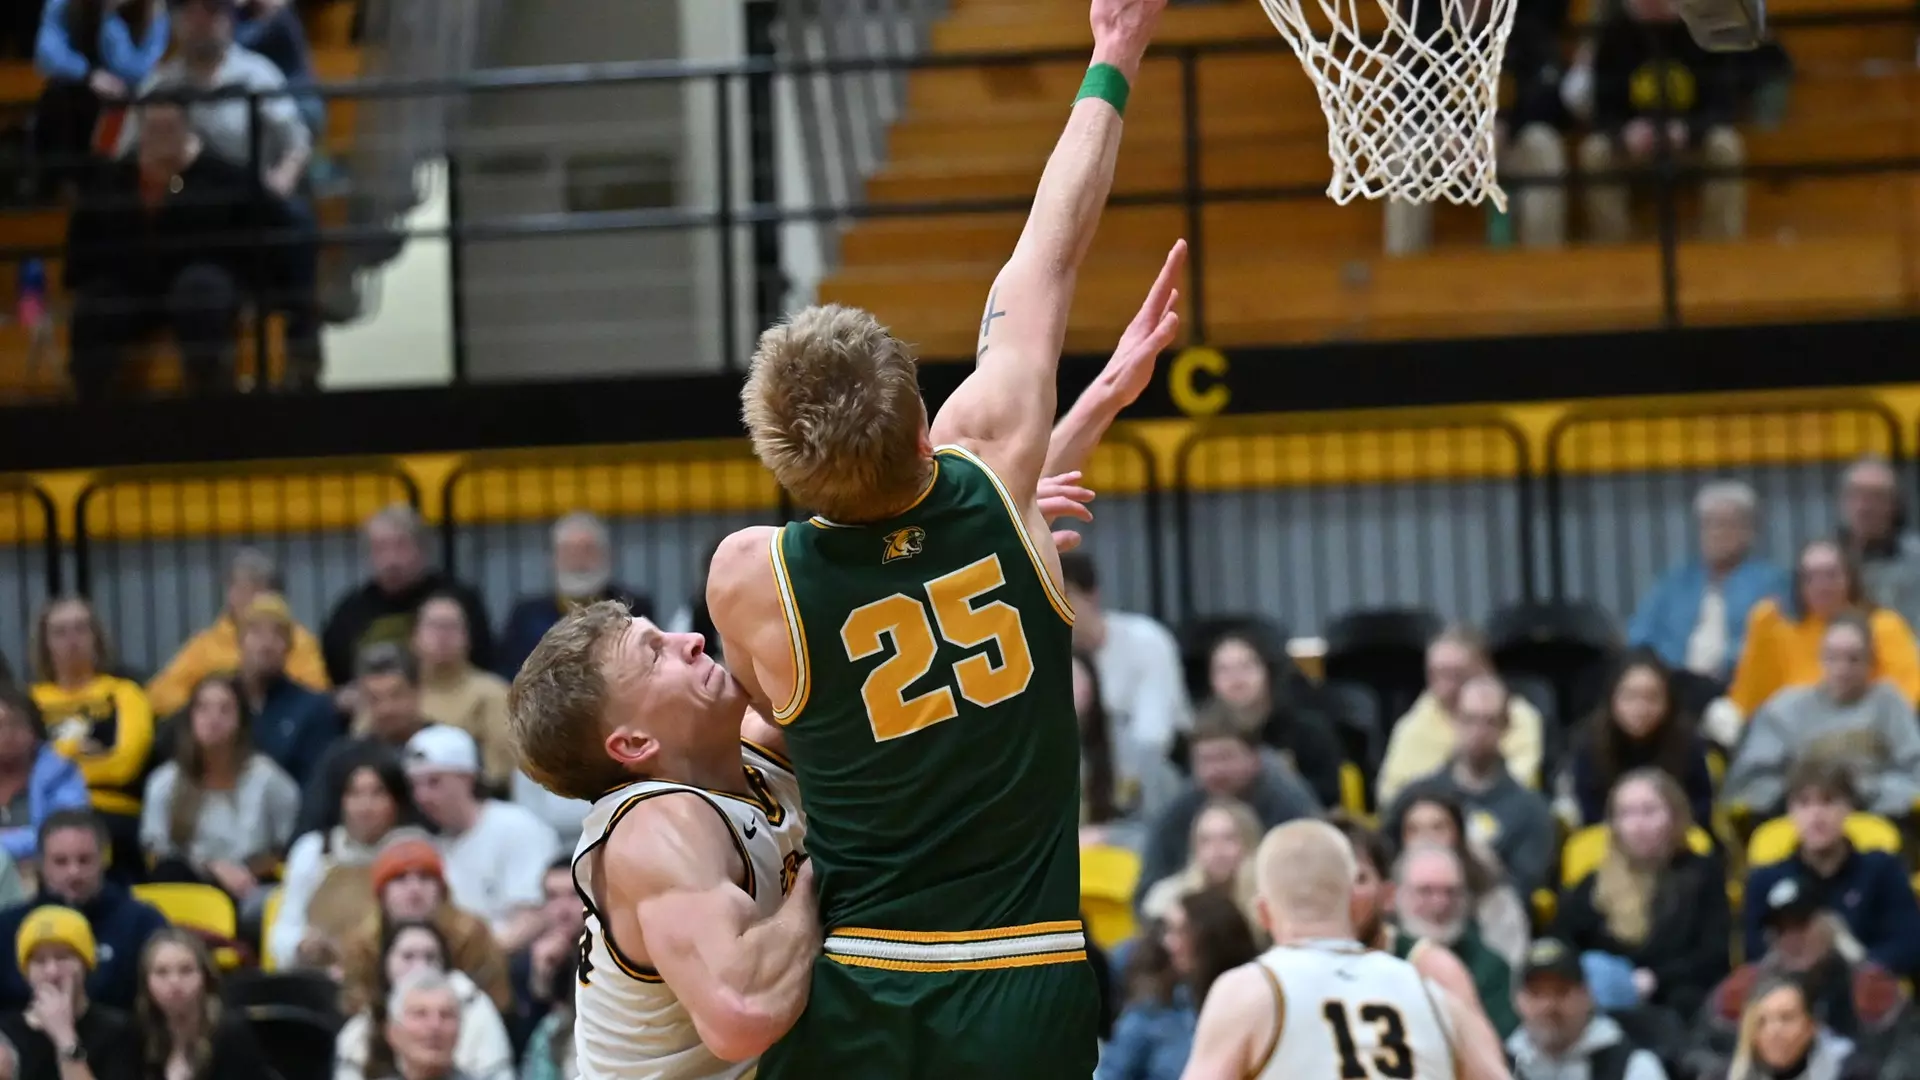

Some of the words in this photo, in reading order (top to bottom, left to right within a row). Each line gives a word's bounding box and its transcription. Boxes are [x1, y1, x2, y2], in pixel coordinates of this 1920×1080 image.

[1169, 348, 1230, 414] C
[840, 552, 1034, 742] 25
[1321, 999, 1415, 1080] 13
